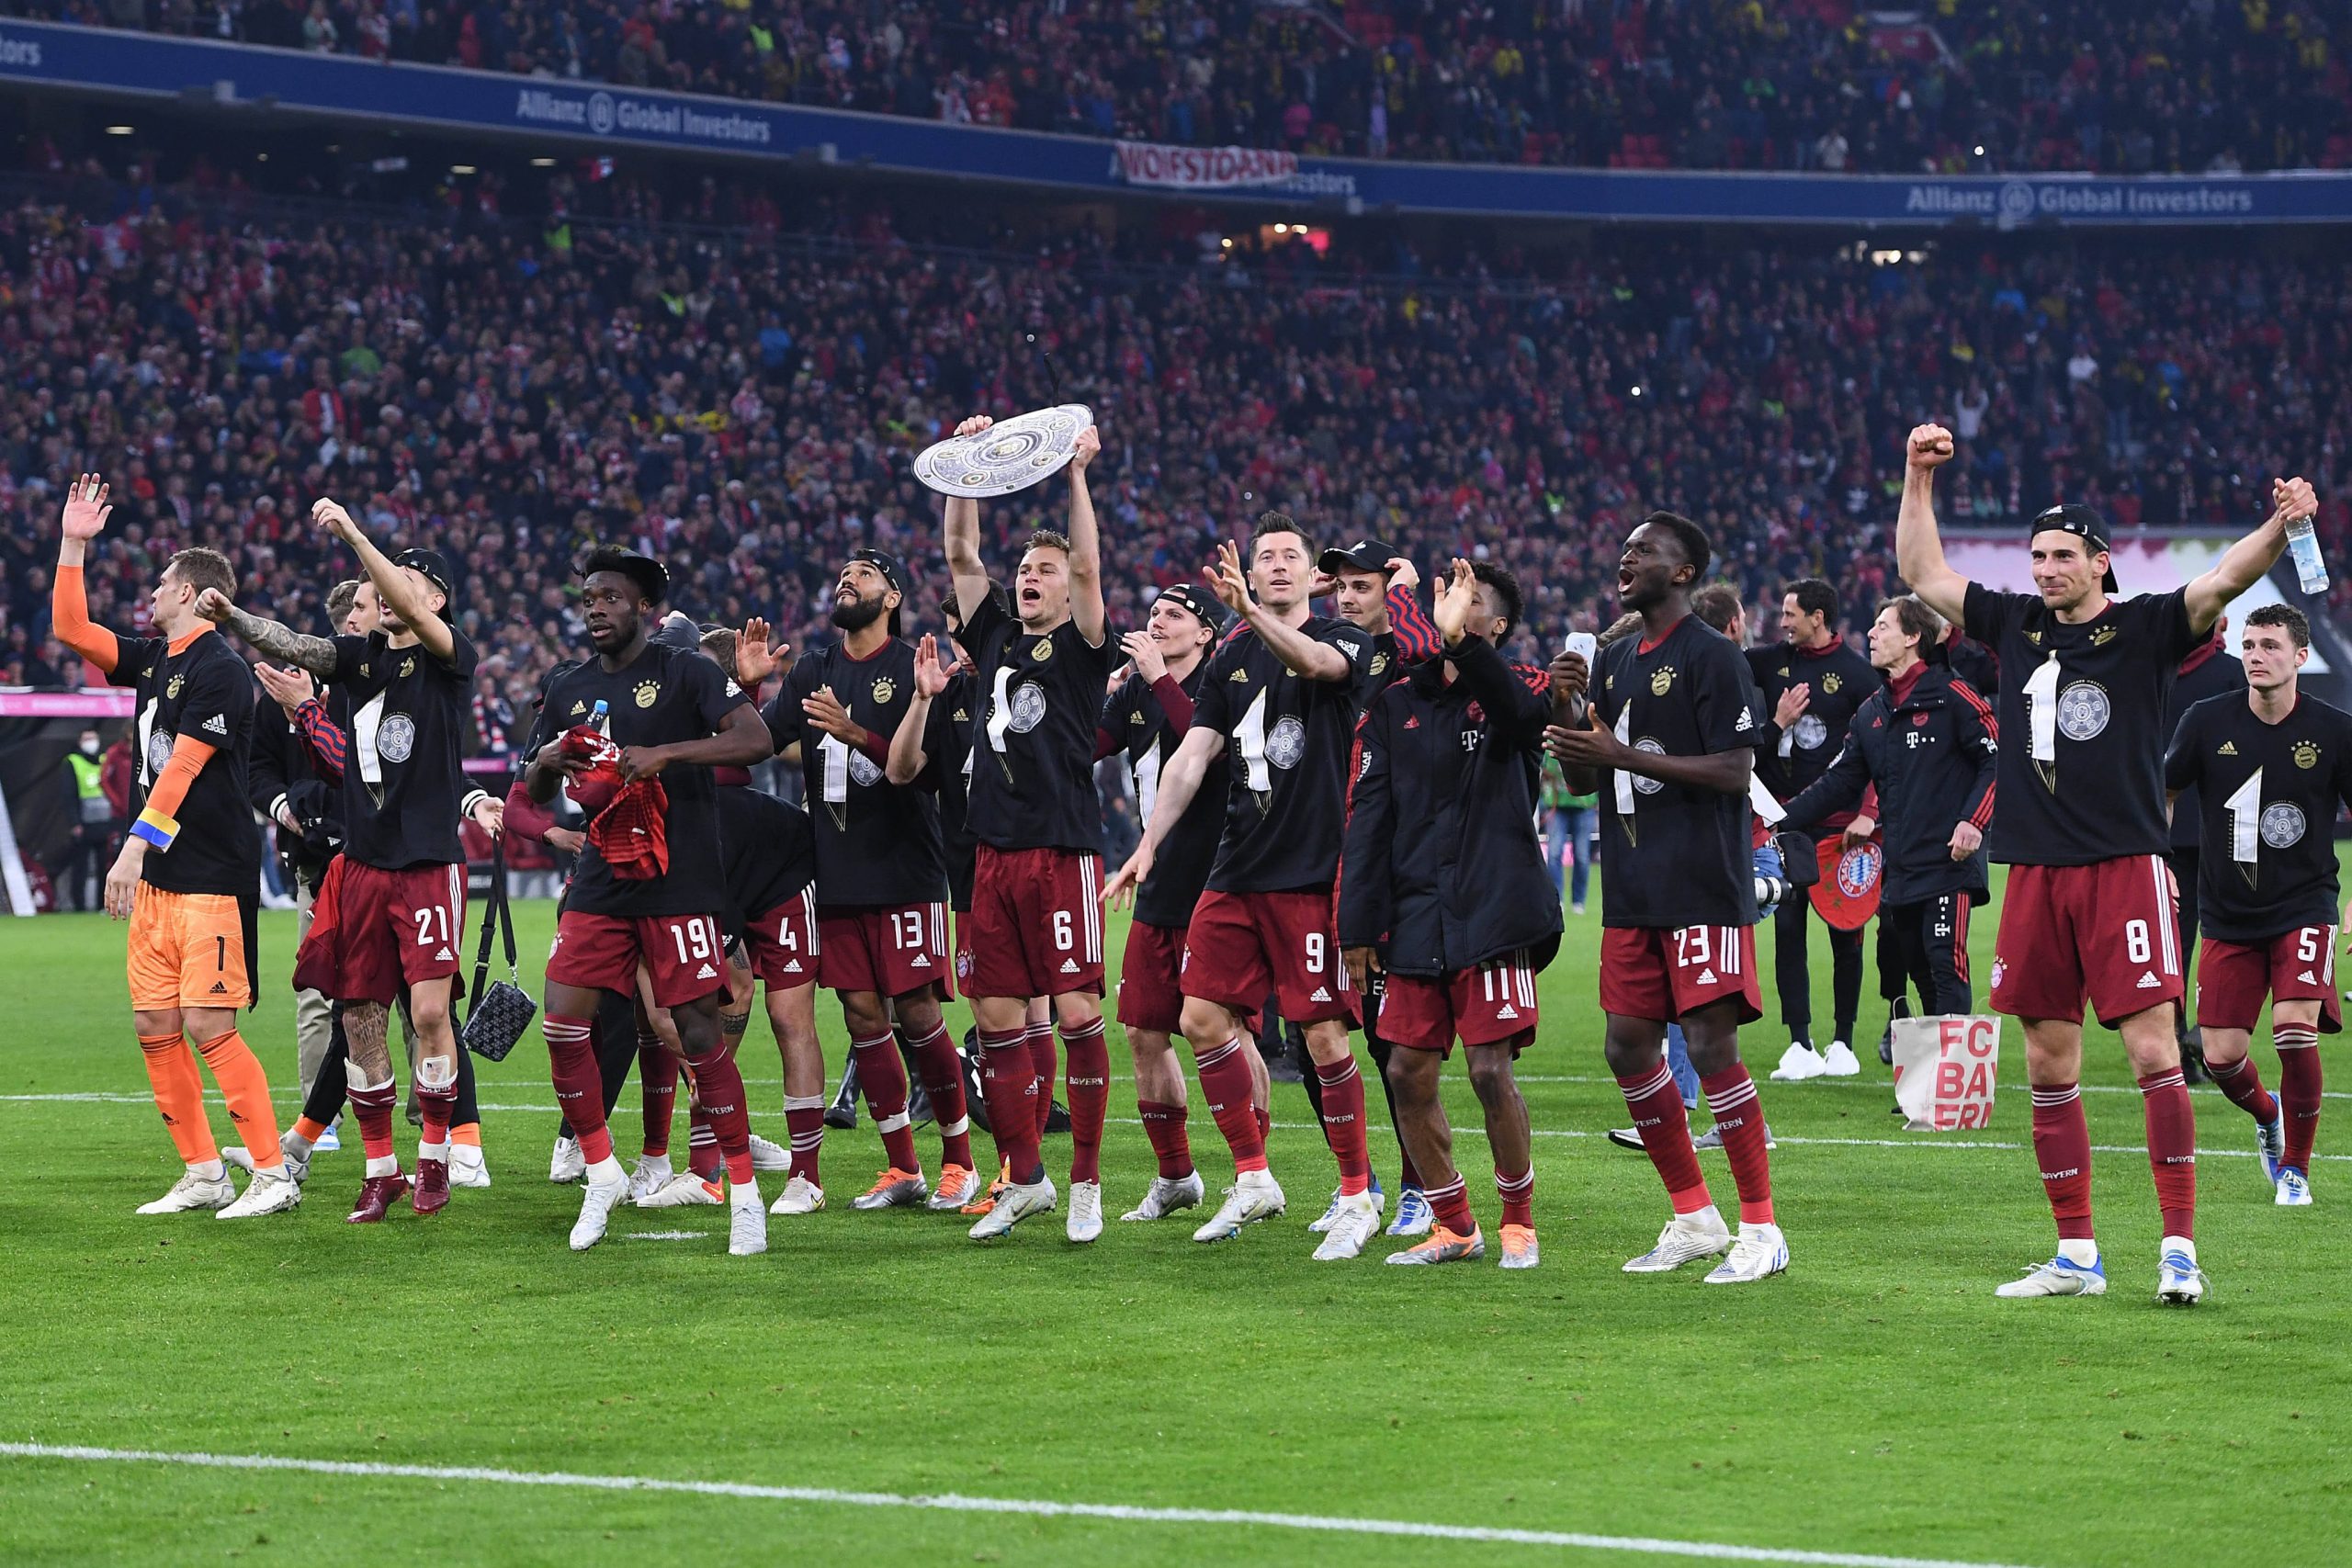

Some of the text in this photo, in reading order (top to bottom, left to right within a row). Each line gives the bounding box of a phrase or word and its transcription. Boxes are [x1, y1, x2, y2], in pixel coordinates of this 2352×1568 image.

[516, 89, 771, 144] Allianz Global Investors
[1906, 186, 2253, 212] Allianz Global Investors
[202, 722, 228, 735] adidas
[415, 906, 448, 946] 21
[671, 919, 710, 964] 19
[778, 917, 797, 952] 4
[890, 910, 923, 950] 13
[1053, 910, 1073, 951] 6
[2126, 919, 2151, 964] 8
[216, 935, 225, 972] 1
[1306, 932, 1324, 974] 9
[1673, 924, 1711, 968] 23
[2297, 927, 2320, 962] 5
[696, 970, 718, 980] adidas
[1480, 961, 1510, 1001] 11
[1939, 1021, 1993, 1057] FC
[1069, 1076, 1102, 1086] BAYERN
[1635, 1117, 1661, 1128] YERN
[1717, 1117, 1744, 1131] YERN
[2041, 1168, 2078, 1180] BAYERN
